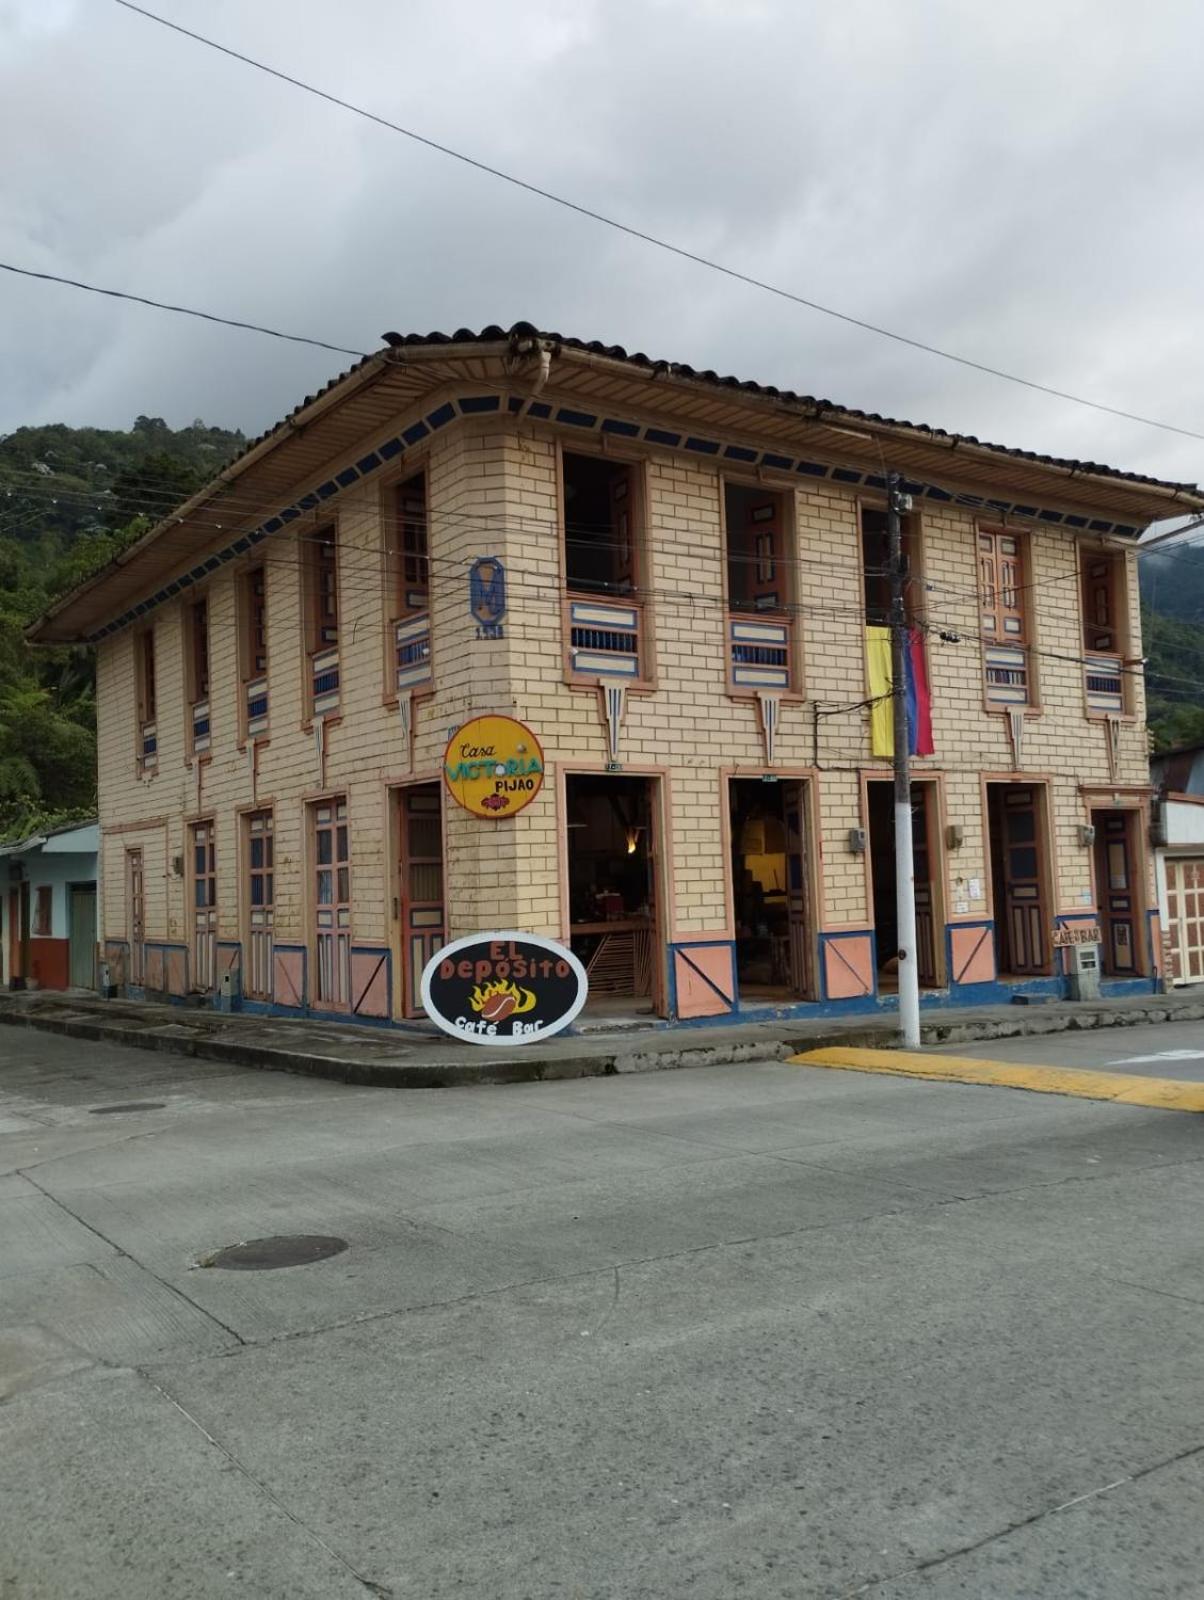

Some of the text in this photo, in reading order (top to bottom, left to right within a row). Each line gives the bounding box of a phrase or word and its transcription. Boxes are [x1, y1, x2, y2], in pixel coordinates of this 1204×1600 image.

[461, 743, 496, 758] Casa
[495, 779, 534, 792] PIJAO
[455, 1015, 543, 1036] Café Bar
